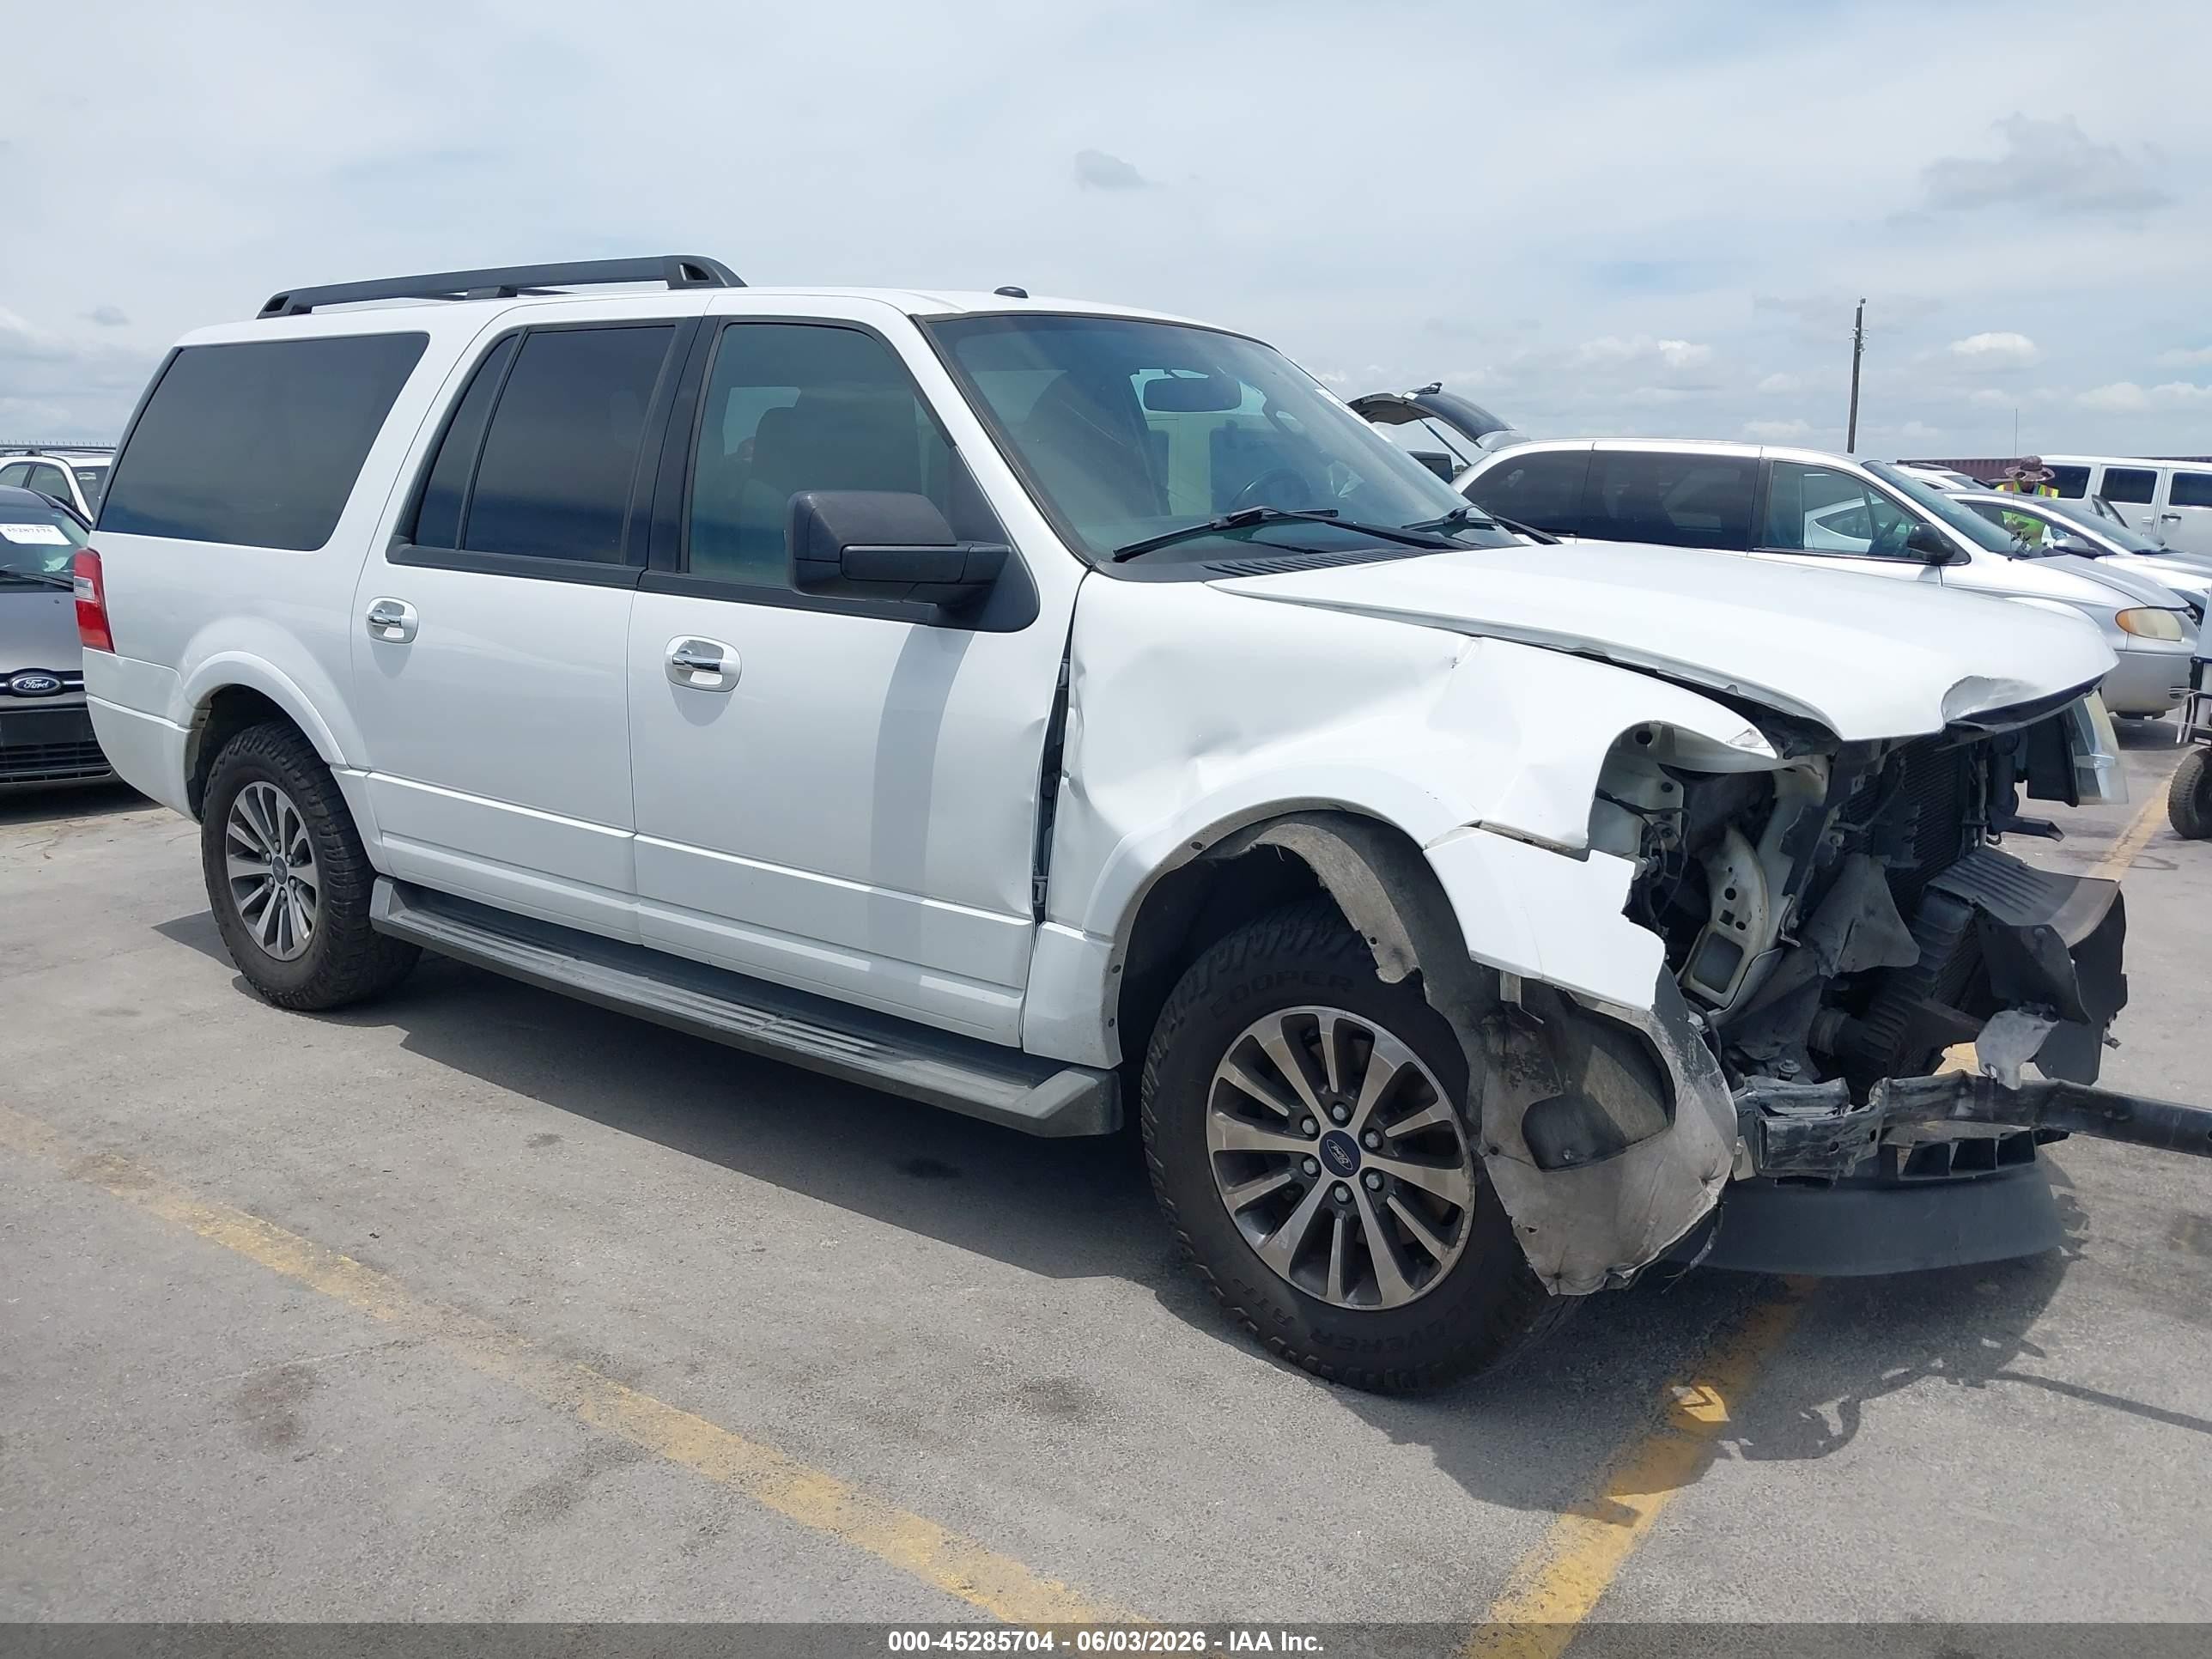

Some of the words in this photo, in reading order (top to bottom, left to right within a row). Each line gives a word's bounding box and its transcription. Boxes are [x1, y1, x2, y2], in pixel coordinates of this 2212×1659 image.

[23, 679, 49, 689] Ford
[1208, 969, 1356, 1021] COOPER
[1330, 1144, 1349, 1164] Ford
